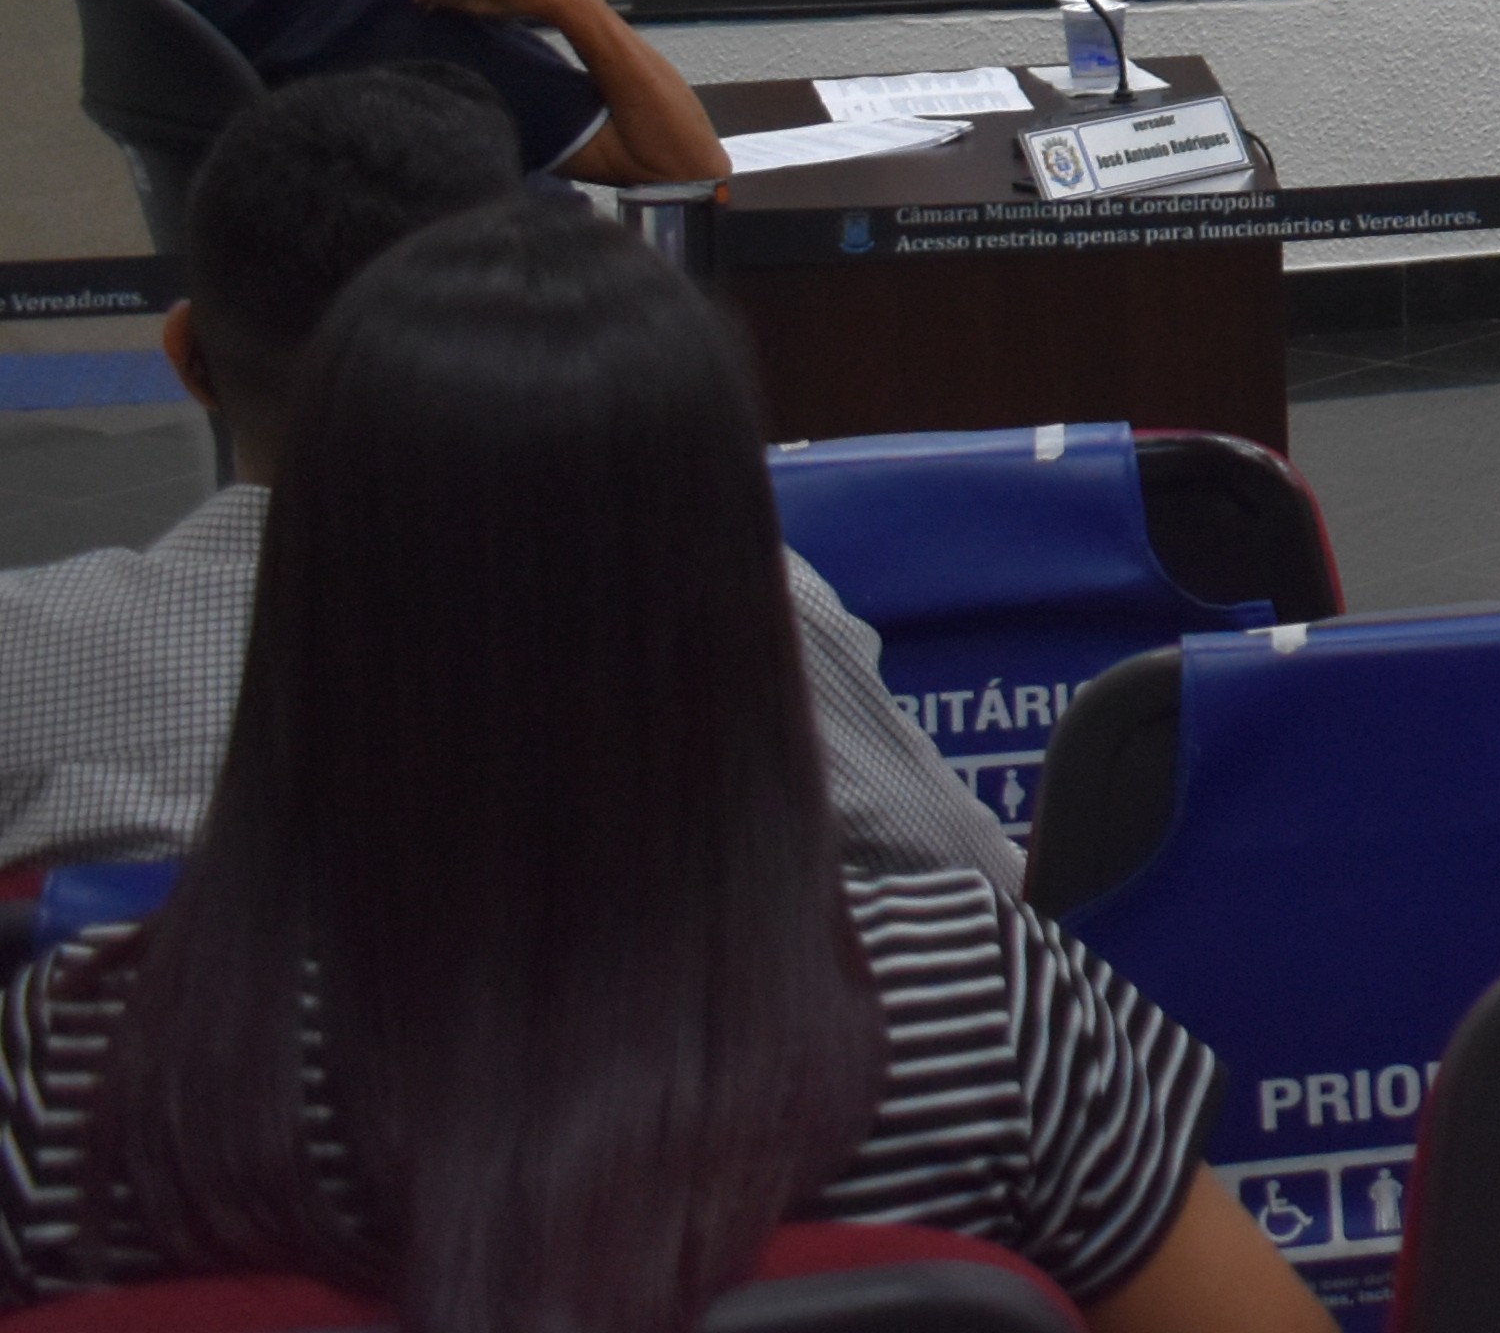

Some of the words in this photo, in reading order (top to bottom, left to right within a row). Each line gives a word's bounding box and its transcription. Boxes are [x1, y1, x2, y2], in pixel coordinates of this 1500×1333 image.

[1132, 114, 1176, 132] vereador
[1095, 150, 1123, 170] José
[1124, 142, 1170, 164] Antonio
[1170, 132, 1230, 155] Rodrigues
[896, 205, 978, 224] Câmara
[985, 200, 1091, 222] Municipal
[1100, 197, 1125, 216] de
[1130, 193, 1276, 215] Cordeirópolis
[896, 235, 970, 252] Acesso
[976, 230, 1059, 249] restrito
[1063, 227, 1140, 250] apenas
[1145, 224, 1194, 249] para
[1201, 216, 1334, 240] funcionários
[1340, 218, 1351, 232] e
[1357, 209, 1482, 232] Vereadores.
[11, 290, 148, 312] Vereadores.
